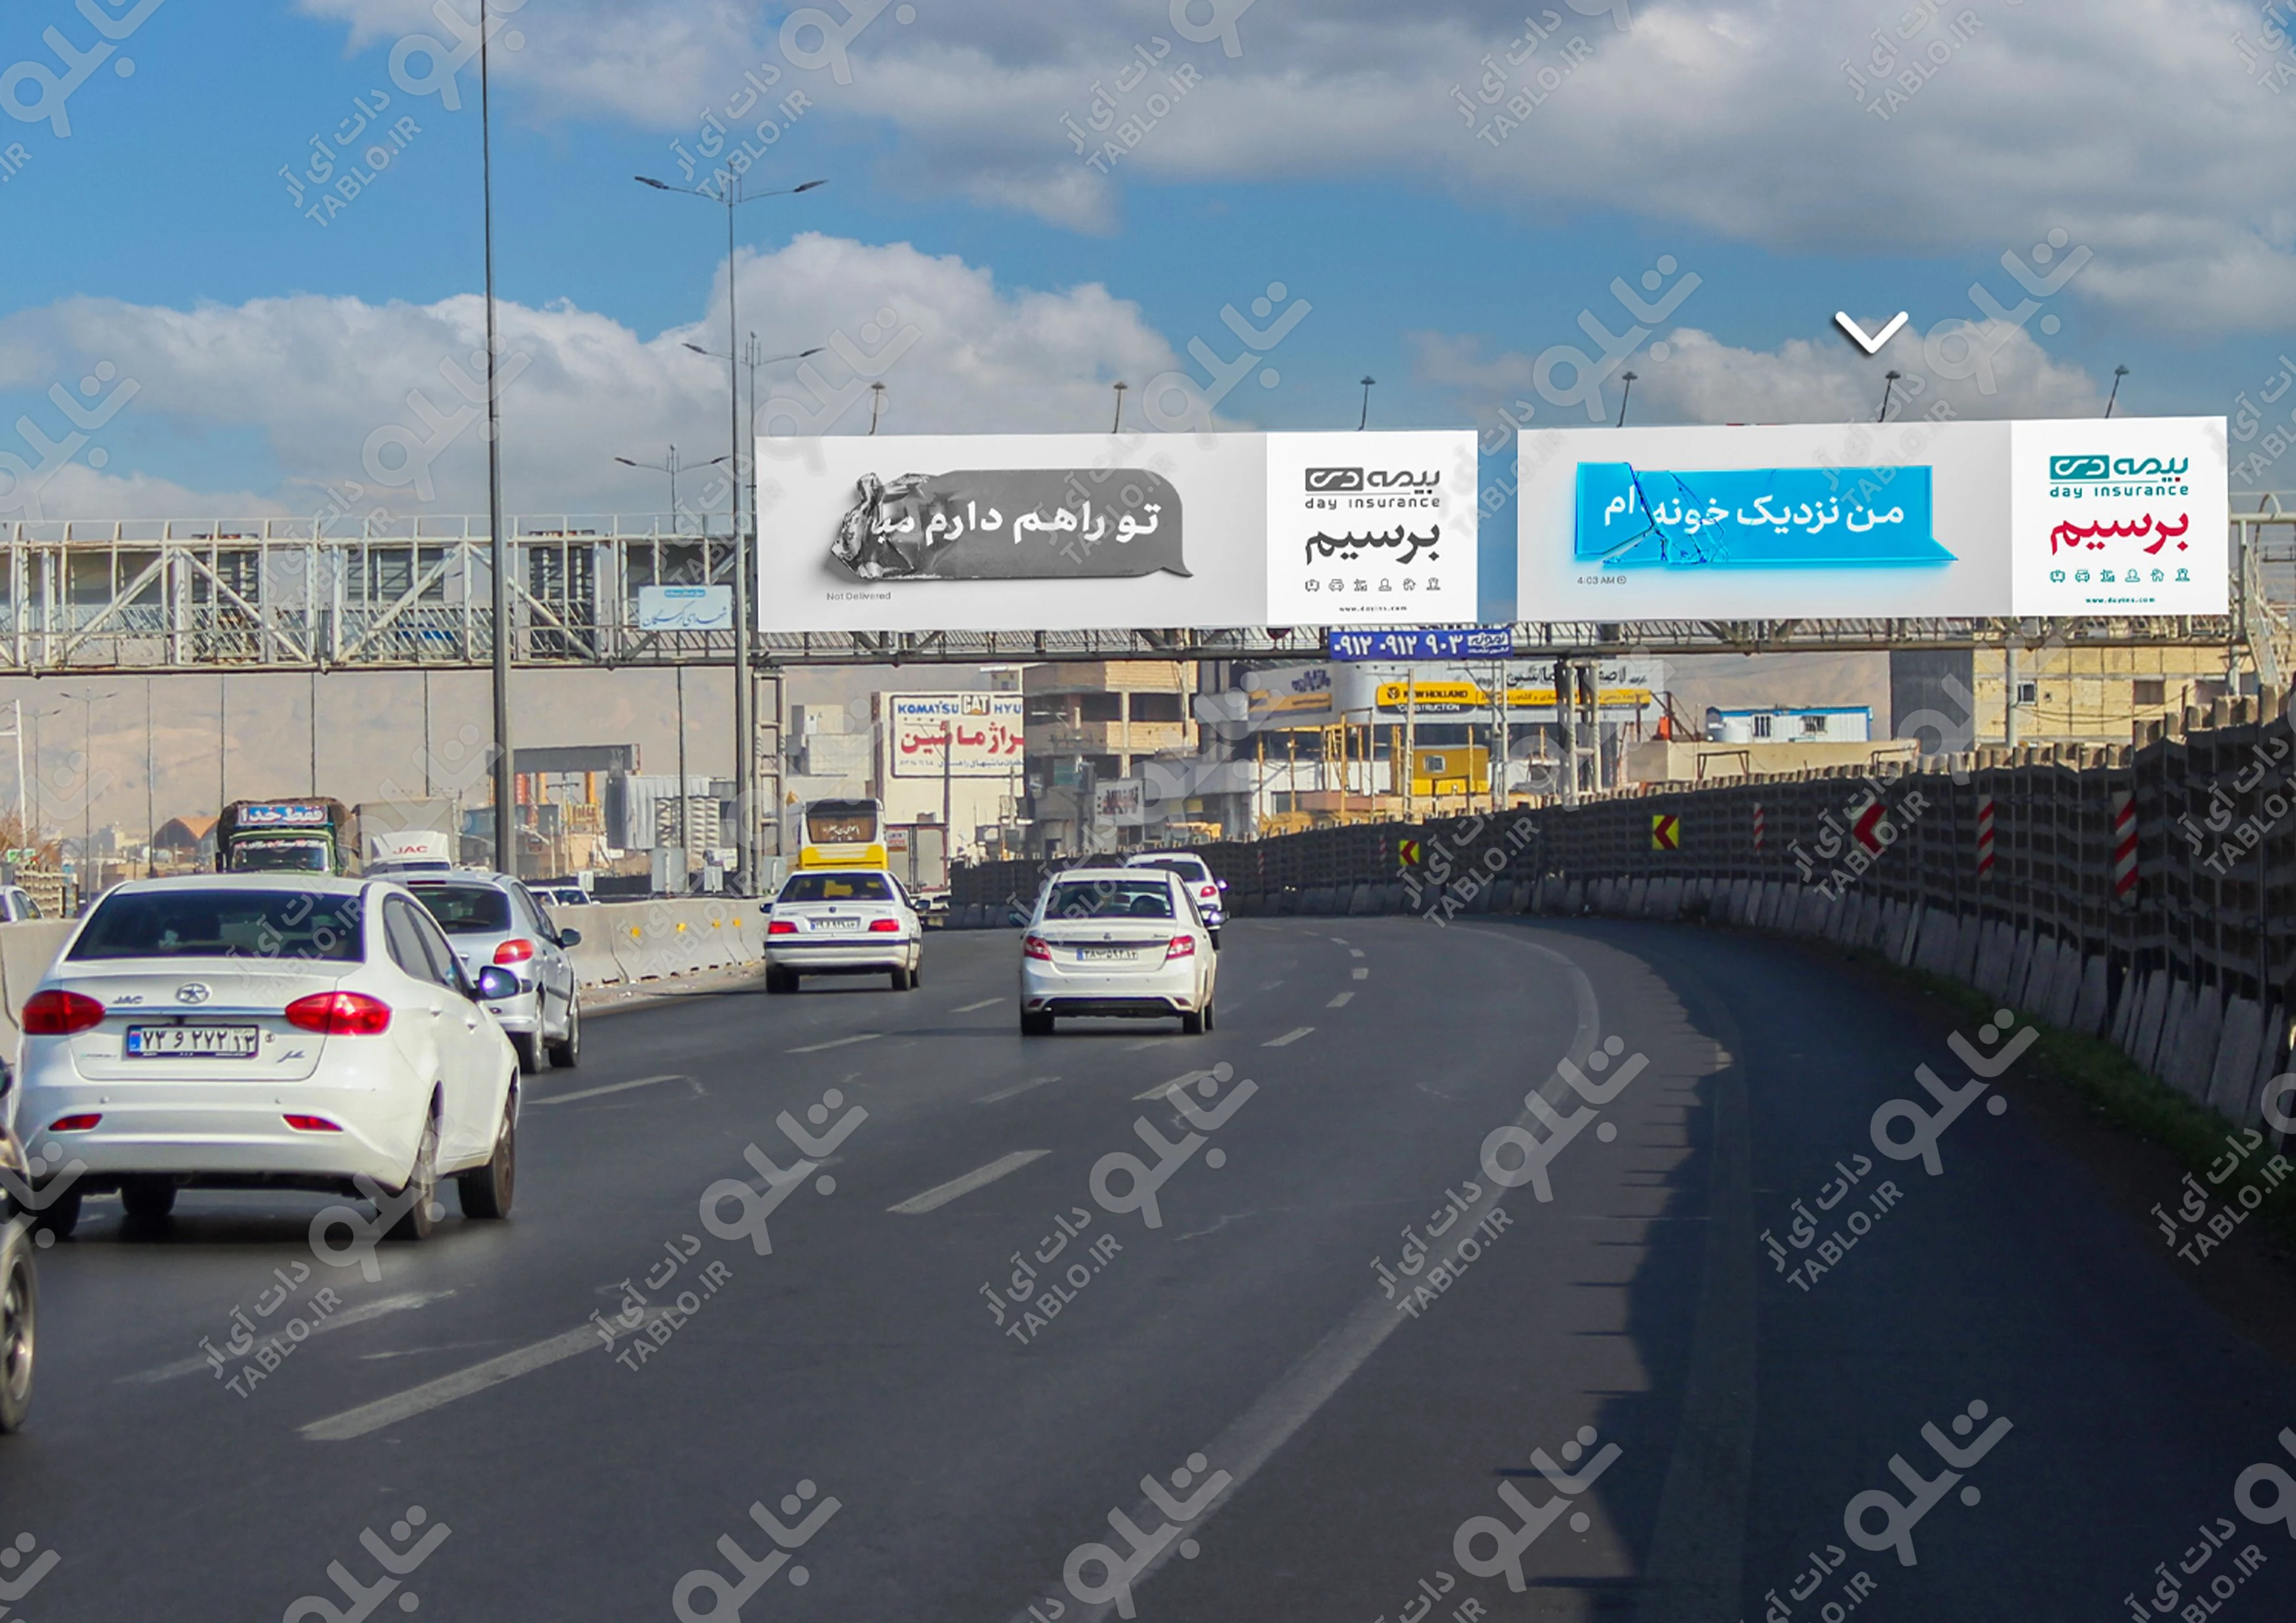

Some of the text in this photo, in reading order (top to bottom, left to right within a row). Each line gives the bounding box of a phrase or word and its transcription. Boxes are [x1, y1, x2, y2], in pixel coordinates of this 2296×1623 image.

[1367, 469, 1441, 495] بیمه
[2113, 457, 2189, 483] بیمه
[1305, 497, 1440, 510] day insurance
[2050, 486, 2189, 499] day insurance
[1013, 500, 1105, 544] راهم
[1115, 502, 1162, 543] تو
[1604, 484, 1905, 535] من نزدیک خونه ام
[925, 500, 1003, 546] دارم
[2050, 512, 2189, 556] برسیم
[1305, 524, 1440, 565] برسیم
[1577, 576, 1615, 585] 4:03 AM
[827, 591, 891, 600] Not Delivered
[898, 703, 959, 714] KOMATSU
[962, 695, 990, 715] CAT
[901, 720, 986, 754] ماشین
[283, 804, 325, 823] فقط
[393, 846, 428, 854] JAC
